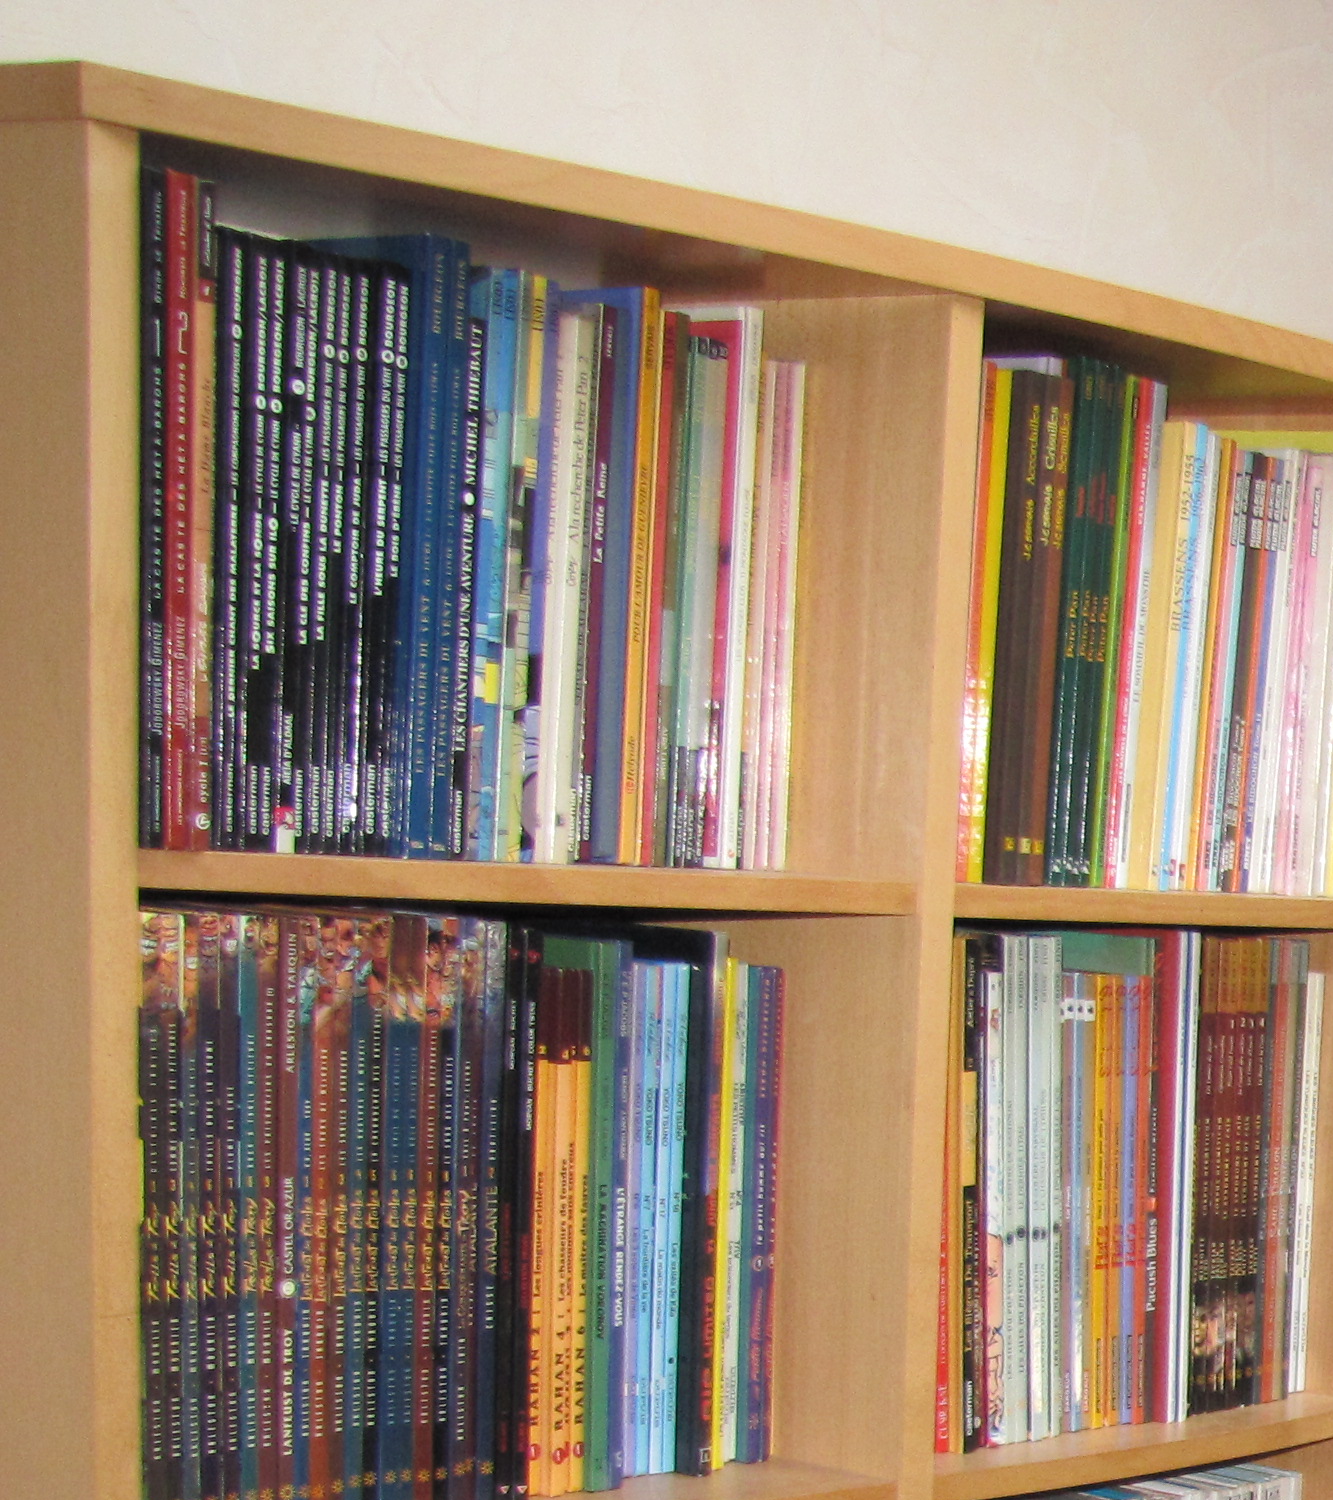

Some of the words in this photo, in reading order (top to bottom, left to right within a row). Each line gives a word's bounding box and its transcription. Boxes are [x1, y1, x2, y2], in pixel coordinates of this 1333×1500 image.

[234, 248, 242, 322] BOURGEON
[326, 269, 338, 340] BOURGEON
[257, 256, 268, 392] BOURGEON/LACROIX
[272, 260, 285, 394] BOURGEON/LACROIX
[306, 270, 320, 402] BOURGEON/LACROIX
[358, 278, 370, 346] BOURGEON
[384, 280, 396, 348] BOURGEON
[382, 368, 392, 387] VENT
[467, 324, 483, 412] THIEBAUT
[332, 484, 344, 537] PONTON
[340, 275, 352, 346] BOURGEON
[378, 404, 392, 448] PASSAGERS
[390, 536, 400, 564] BOIS
[398, 286, 410, 354] BOURGEON
[378, 450, 389, 462] LES
[464, 416, 479, 485] MICHEL
[319, 480, 330, 534] DUNETTE
[352, 478, 362, 508] JUDA
[376, 478, 388, 528] SERPENT
[595, 463, 608, 499] Reine
[230, 504, 238, 576] MALATERRE
[252, 514, 263, 560] SONDE
[300, 522, 310, 576] CONFINS
[375, 530, 386, 547] DU
[594, 506, 606, 541] Petite
[1170, 539, 1188, 632] BRASSENS
[1179, 454, 1194, 521] 1952-1955
[266, 544, 278, 570] SUR
[318, 556, 327, 589] SOUS
[349, 528, 359, 589] COMPTOIR
[373, 551, 384, 596] L'HEURE
[460, 513, 475, 590] AVENTURE
[228, 580, 238, 602] DES
[266, 574, 276, 628] SAISONS
[299, 579, 310, 602] DES
[316, 592, 326, 622] FILLE
[420, 596, 430, 632] VENT
[458, 593, 471, 638] D'UNE
[1068, 591, 1080, 619] Pan
[150, 622, 162, 666] GIMENEZ
[174, 616, 186, 660] GIMENEZ
[228, 604, 237, 646] CHANT
[251, 598, 262, 650] SOURCE
[265, 632, 276, 654] SIX
[441, 600, 452, 637] VENT
[1065, 622, 1078, 658] Peter
[228, 650, 236, 702] DERNIER
[415, 662, 428, 743] PASSAGERS
[454, 640, 470, 724] CHANTIERS
[436, 667, 450, 747] PASSAGERS
[414, 750, 424, 774] LES
[436, 753, 446, 777] LES
[453, 726, 466, 752] LES
[225, 762, 234, 834] casterman
[248, 766, 258, 836] casterman
[260, 766, 271, 836] casterman
[293, 770, 304, 838] casterman
[310, 766, 320, 834] casterman
[324, 770, 336, 838] casterman
[364, 764, 376, 836] casterman
[380, 768, 392, 838] casterman
[452, 790, 464, 854] casterman
[582, 774, 593, 840] casterman
[286, 932, 298, 990] TARQUIN
[284, 1008, 296, 1074] ARLESTON
[558, 1158, 568, 1201] foudre
[579, 1174, 589, 1223] fauves
[483, 1186, 498, 1275] ATALANTE
[558, 1202, 567, 1216] de
[578, 1226, 588, 1242] des
[284, 1230, 294, 1274] CASTEL
[532, 1228, 544, 1276] longues
[558, 1220, 567, 1280] chasseurs
[1146, 1218, 1158, 1257] Blues
[613, 1252, 625, 1328] RENDEZ-VOUS
[1146, 1260, 1158, 1312] Pacush
[282, 1328, 294, 1364] TROY
[554, 1331, 564, 1340] 4
[576, 1326, 586, 1336] 6
[282, 1370, 294, 1386] DE
[529, 1348, 540, 1428] RAHAN
[554, 1353, 564, 1432] RAHAN
[574, 1348, 586, 1424] RAHAN
[282, 1392, 294, 1456] LANFEUST
[964, 1381, 974, 1436] casterman
